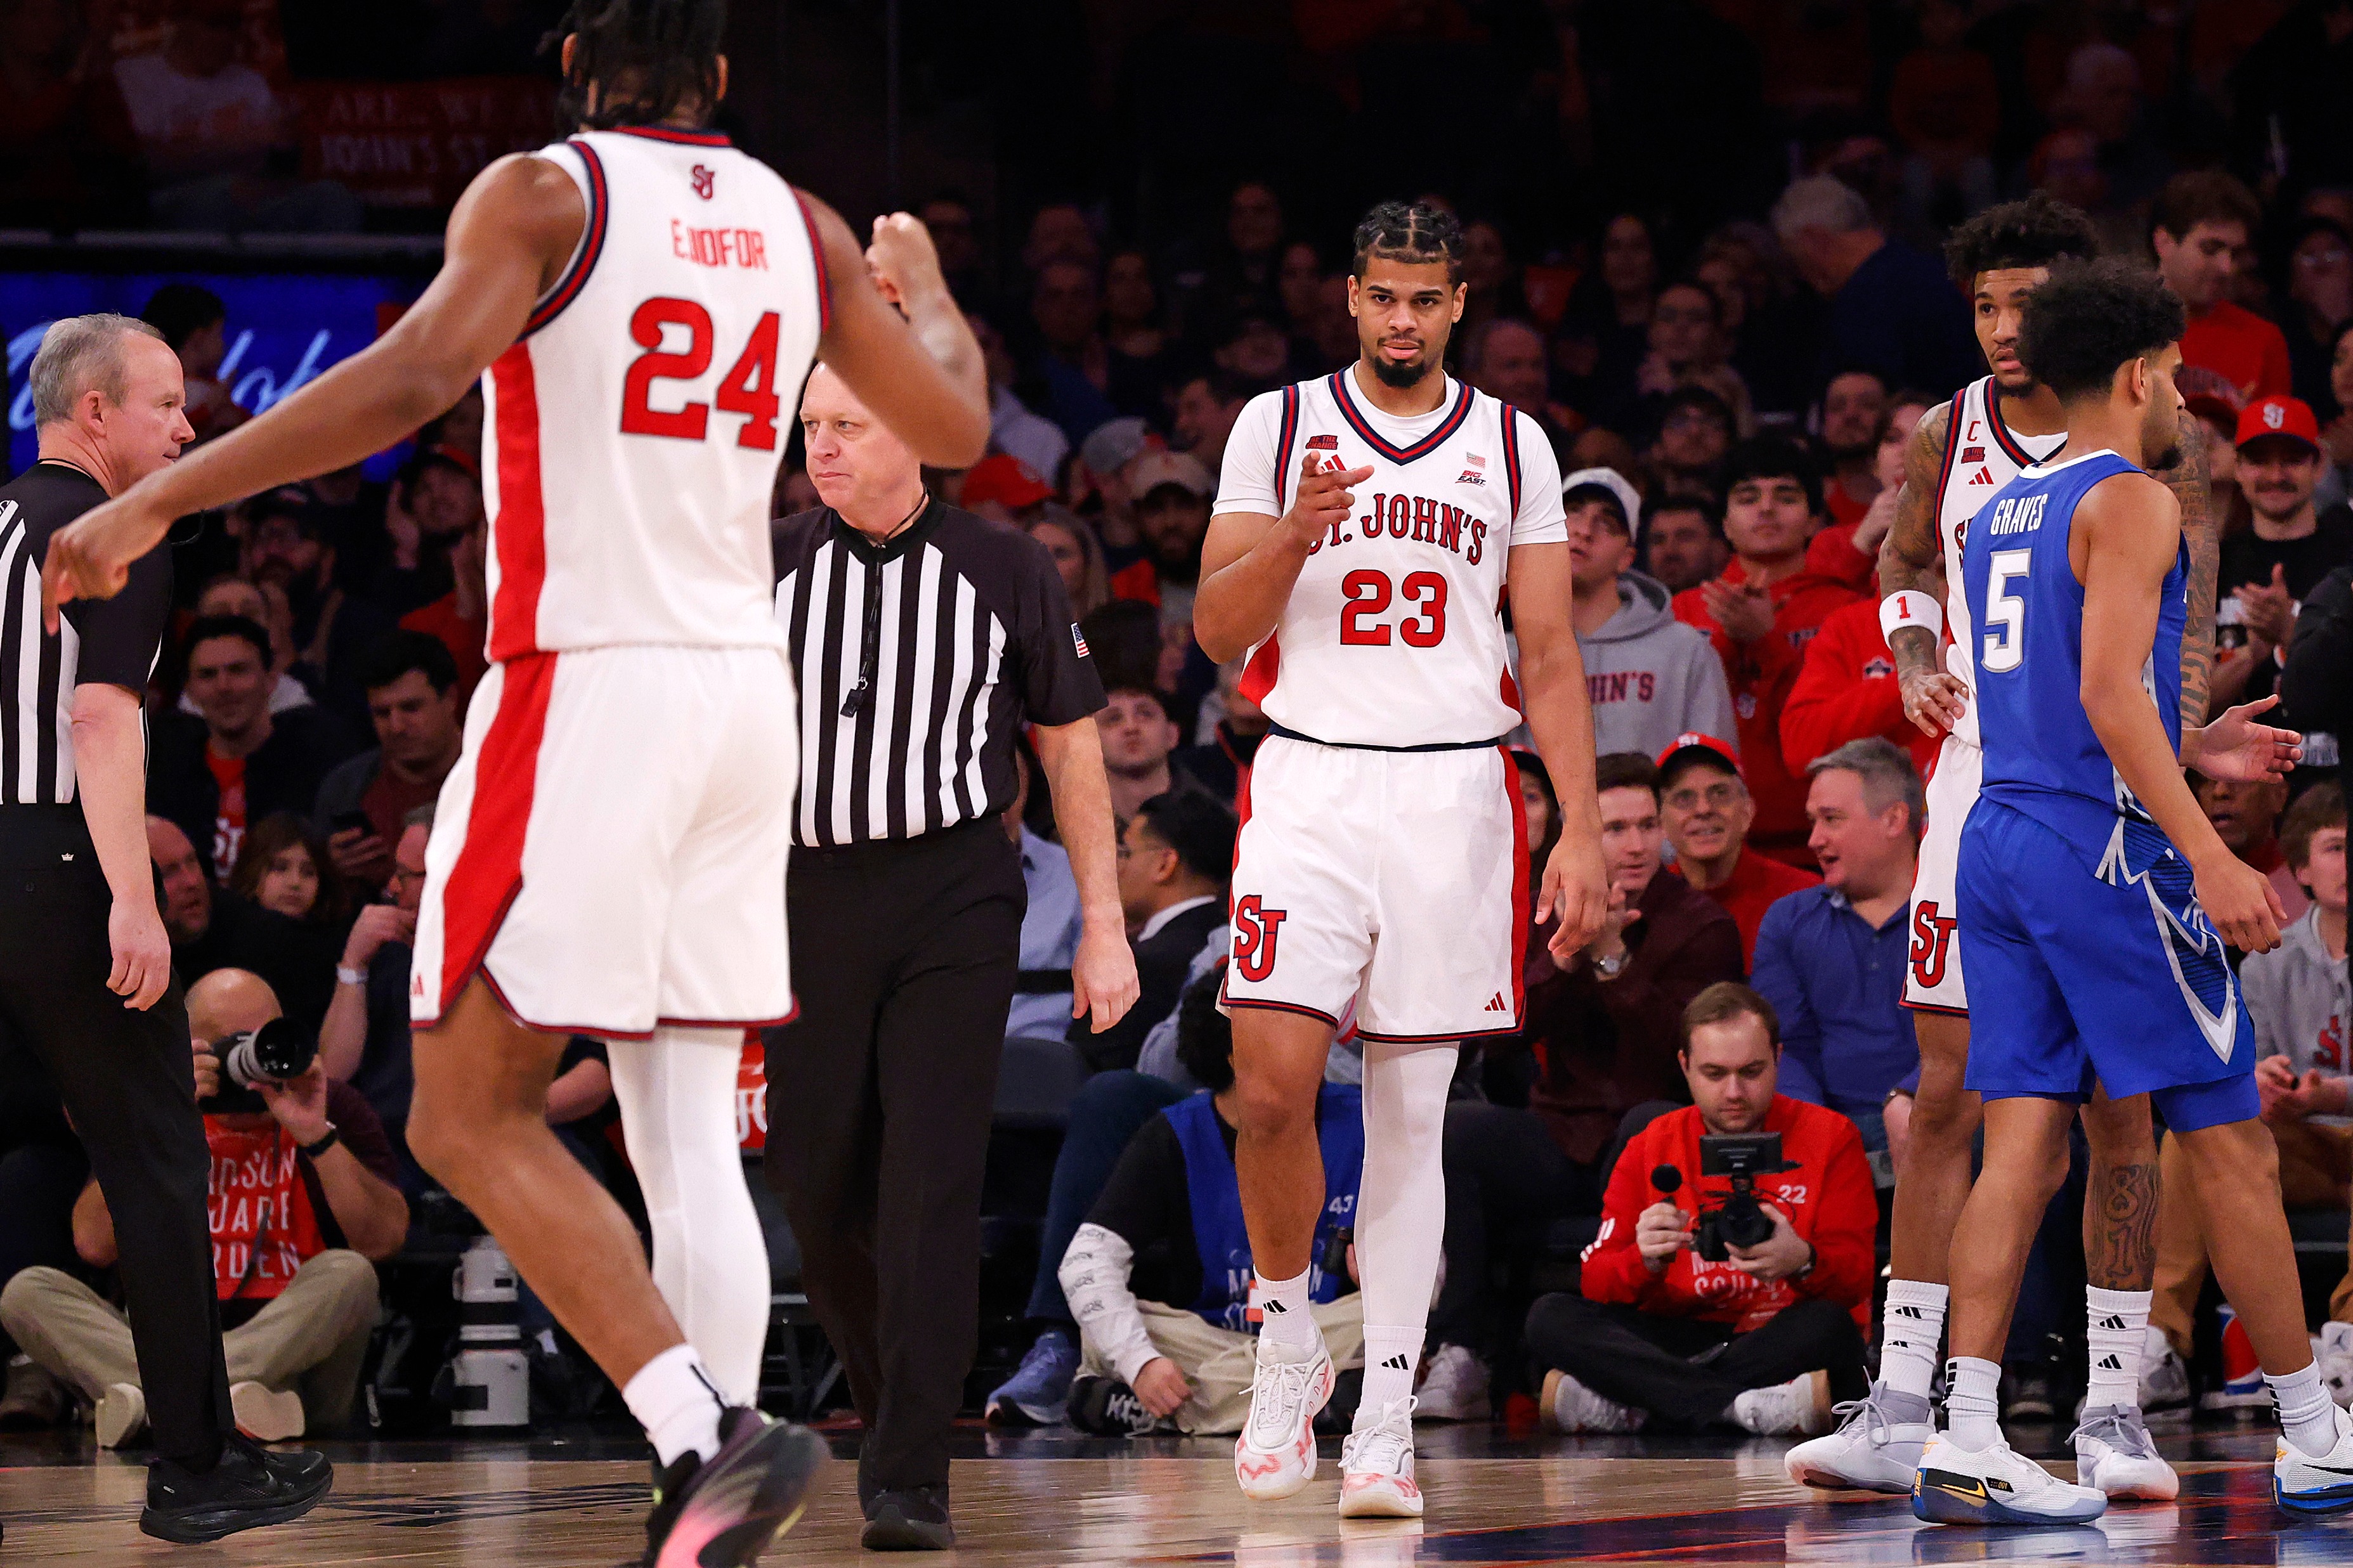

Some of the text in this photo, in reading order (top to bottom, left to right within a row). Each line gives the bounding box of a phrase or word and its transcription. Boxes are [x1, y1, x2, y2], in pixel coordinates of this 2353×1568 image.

[671, 217, 769, 271] EJOFOR
[620, 296, 780, 452] 24
[1967, 420, 1981, 441] C
[1457, 476, 1486, 484] EAST
[1462, 470, 1482, 478] BIG
[1360, 493, 1487, 566] JOHN'S
[1990, 493, 2049, 536] GRAVES
[1340, 569, 1448, 648] 23
[1897, 595, 1911, 619] 1
[1981, 548, 2031, 673] 5
[1233, 894, 1287, 982] SJ
[1910, 900, 1957, 988] SJ
[1776, 1184, 1807, 1204] 22
